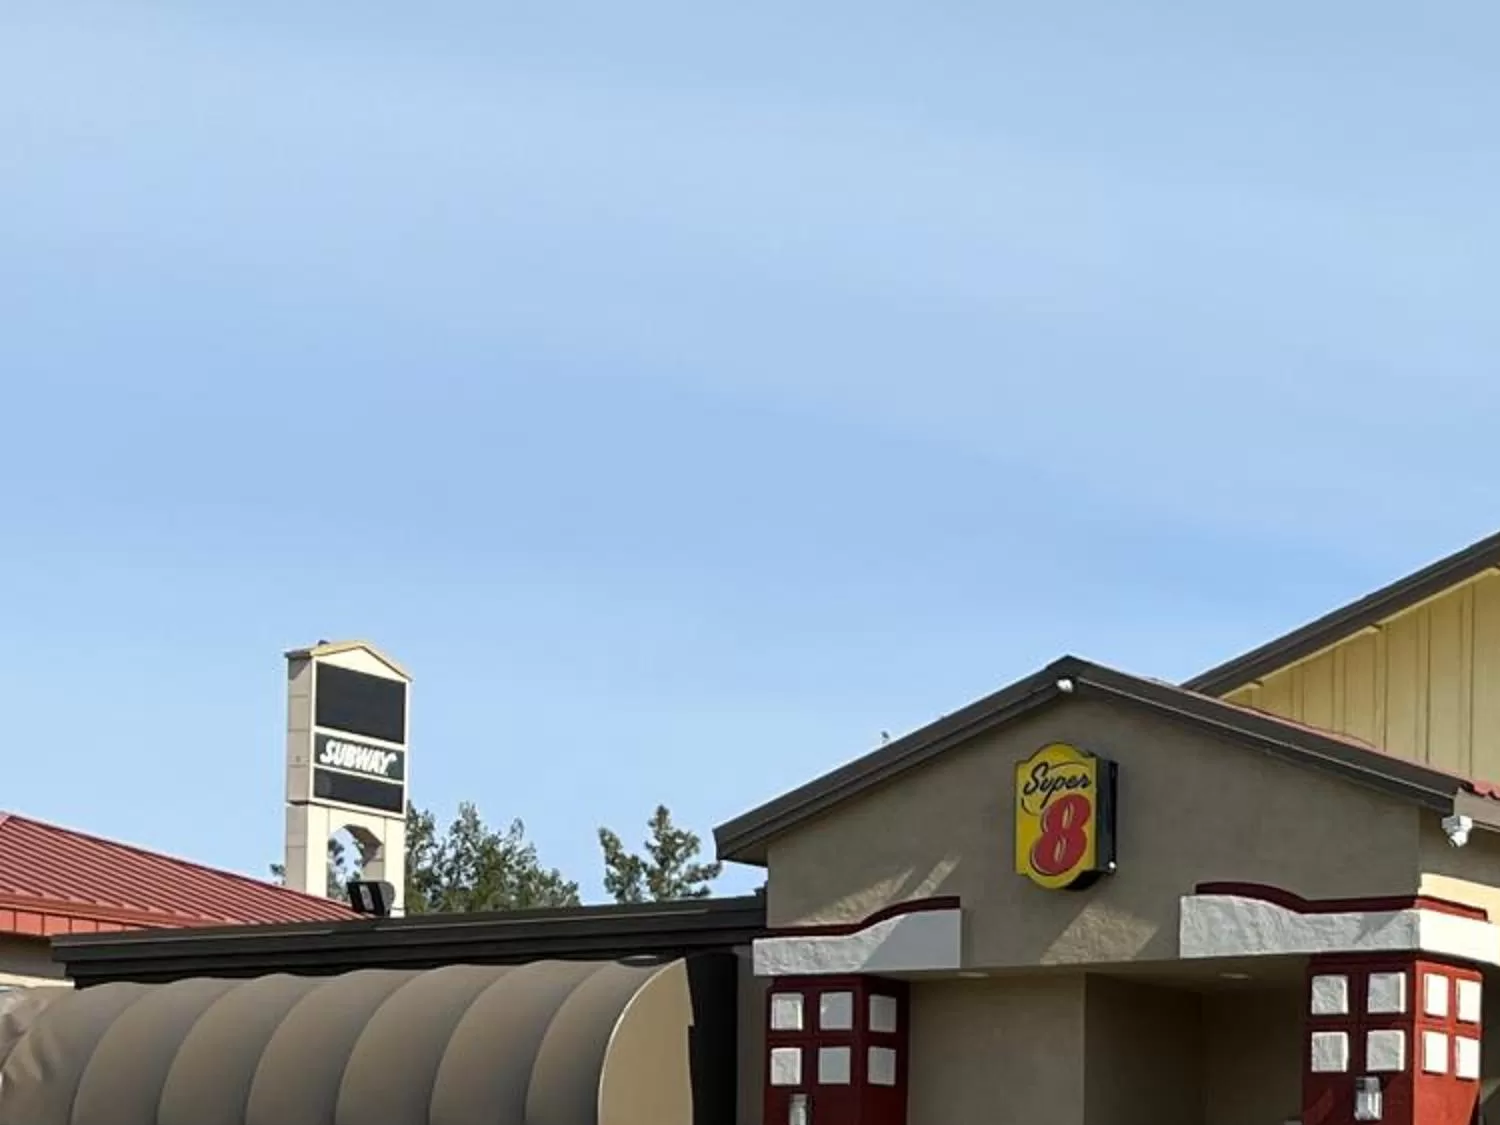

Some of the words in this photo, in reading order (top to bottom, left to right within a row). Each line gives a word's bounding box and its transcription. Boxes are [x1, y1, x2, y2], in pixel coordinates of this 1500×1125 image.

[320, 739, 397, 775] SUBWAY
[1023, 762, 1091, 808] Super
[1030, 793, 1091, 876] 8
